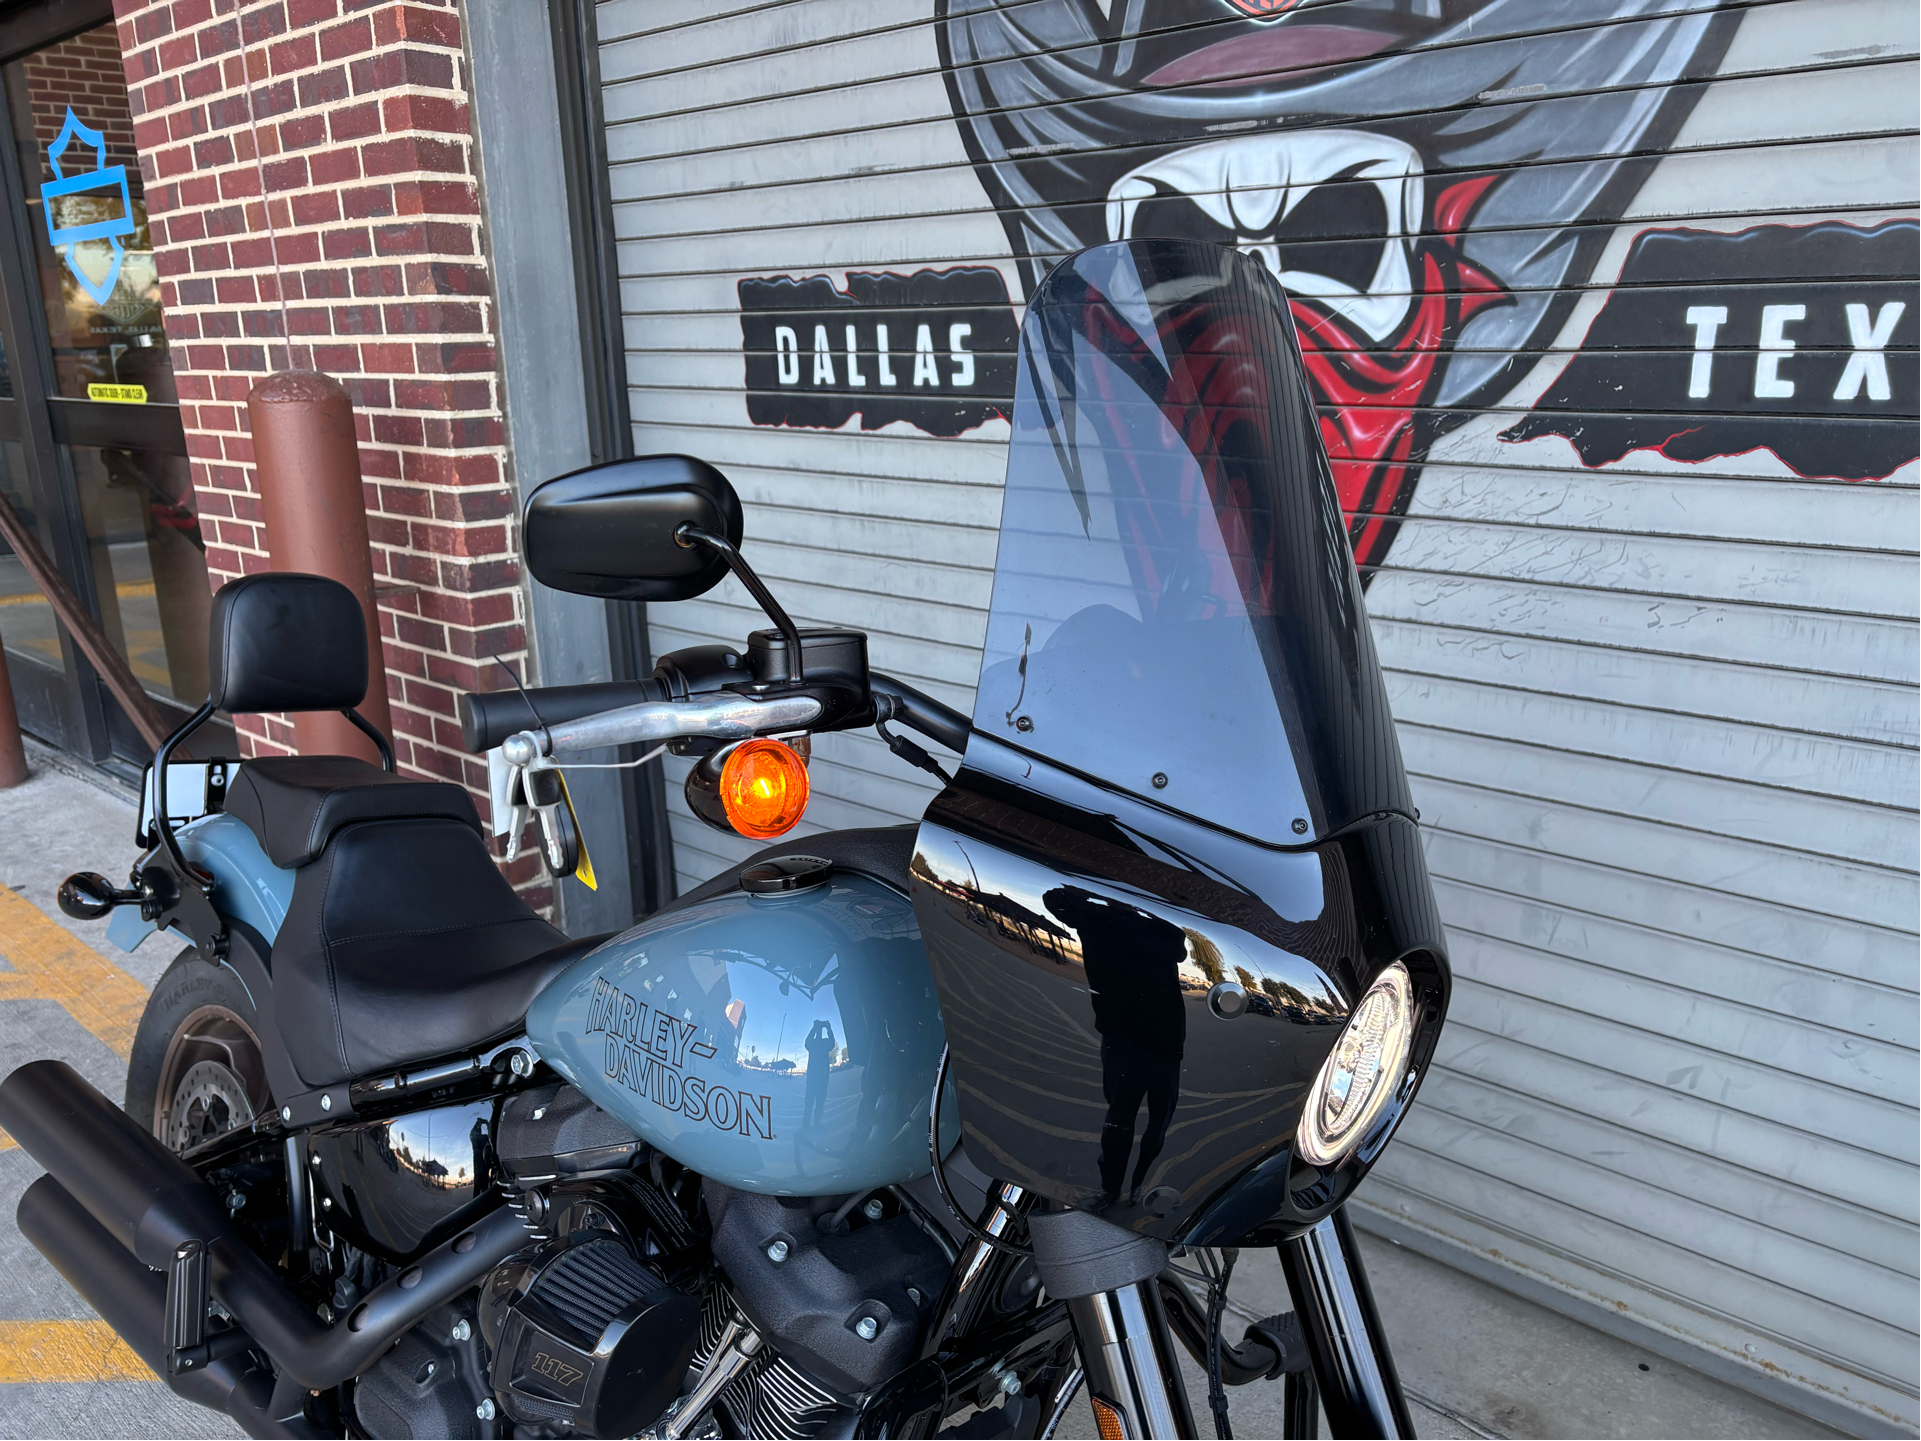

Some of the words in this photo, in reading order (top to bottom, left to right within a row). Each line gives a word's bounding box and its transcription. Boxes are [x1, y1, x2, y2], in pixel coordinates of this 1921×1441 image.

[775, 323, 975, 386] DALLAS
[1686, 302, 1906, 400] TEX
[586, 976, 718, 1068] HARLEY-
[605, 1033, 773, 1140] DAVIDSON
[531, 1352, 584, 1387] 117
